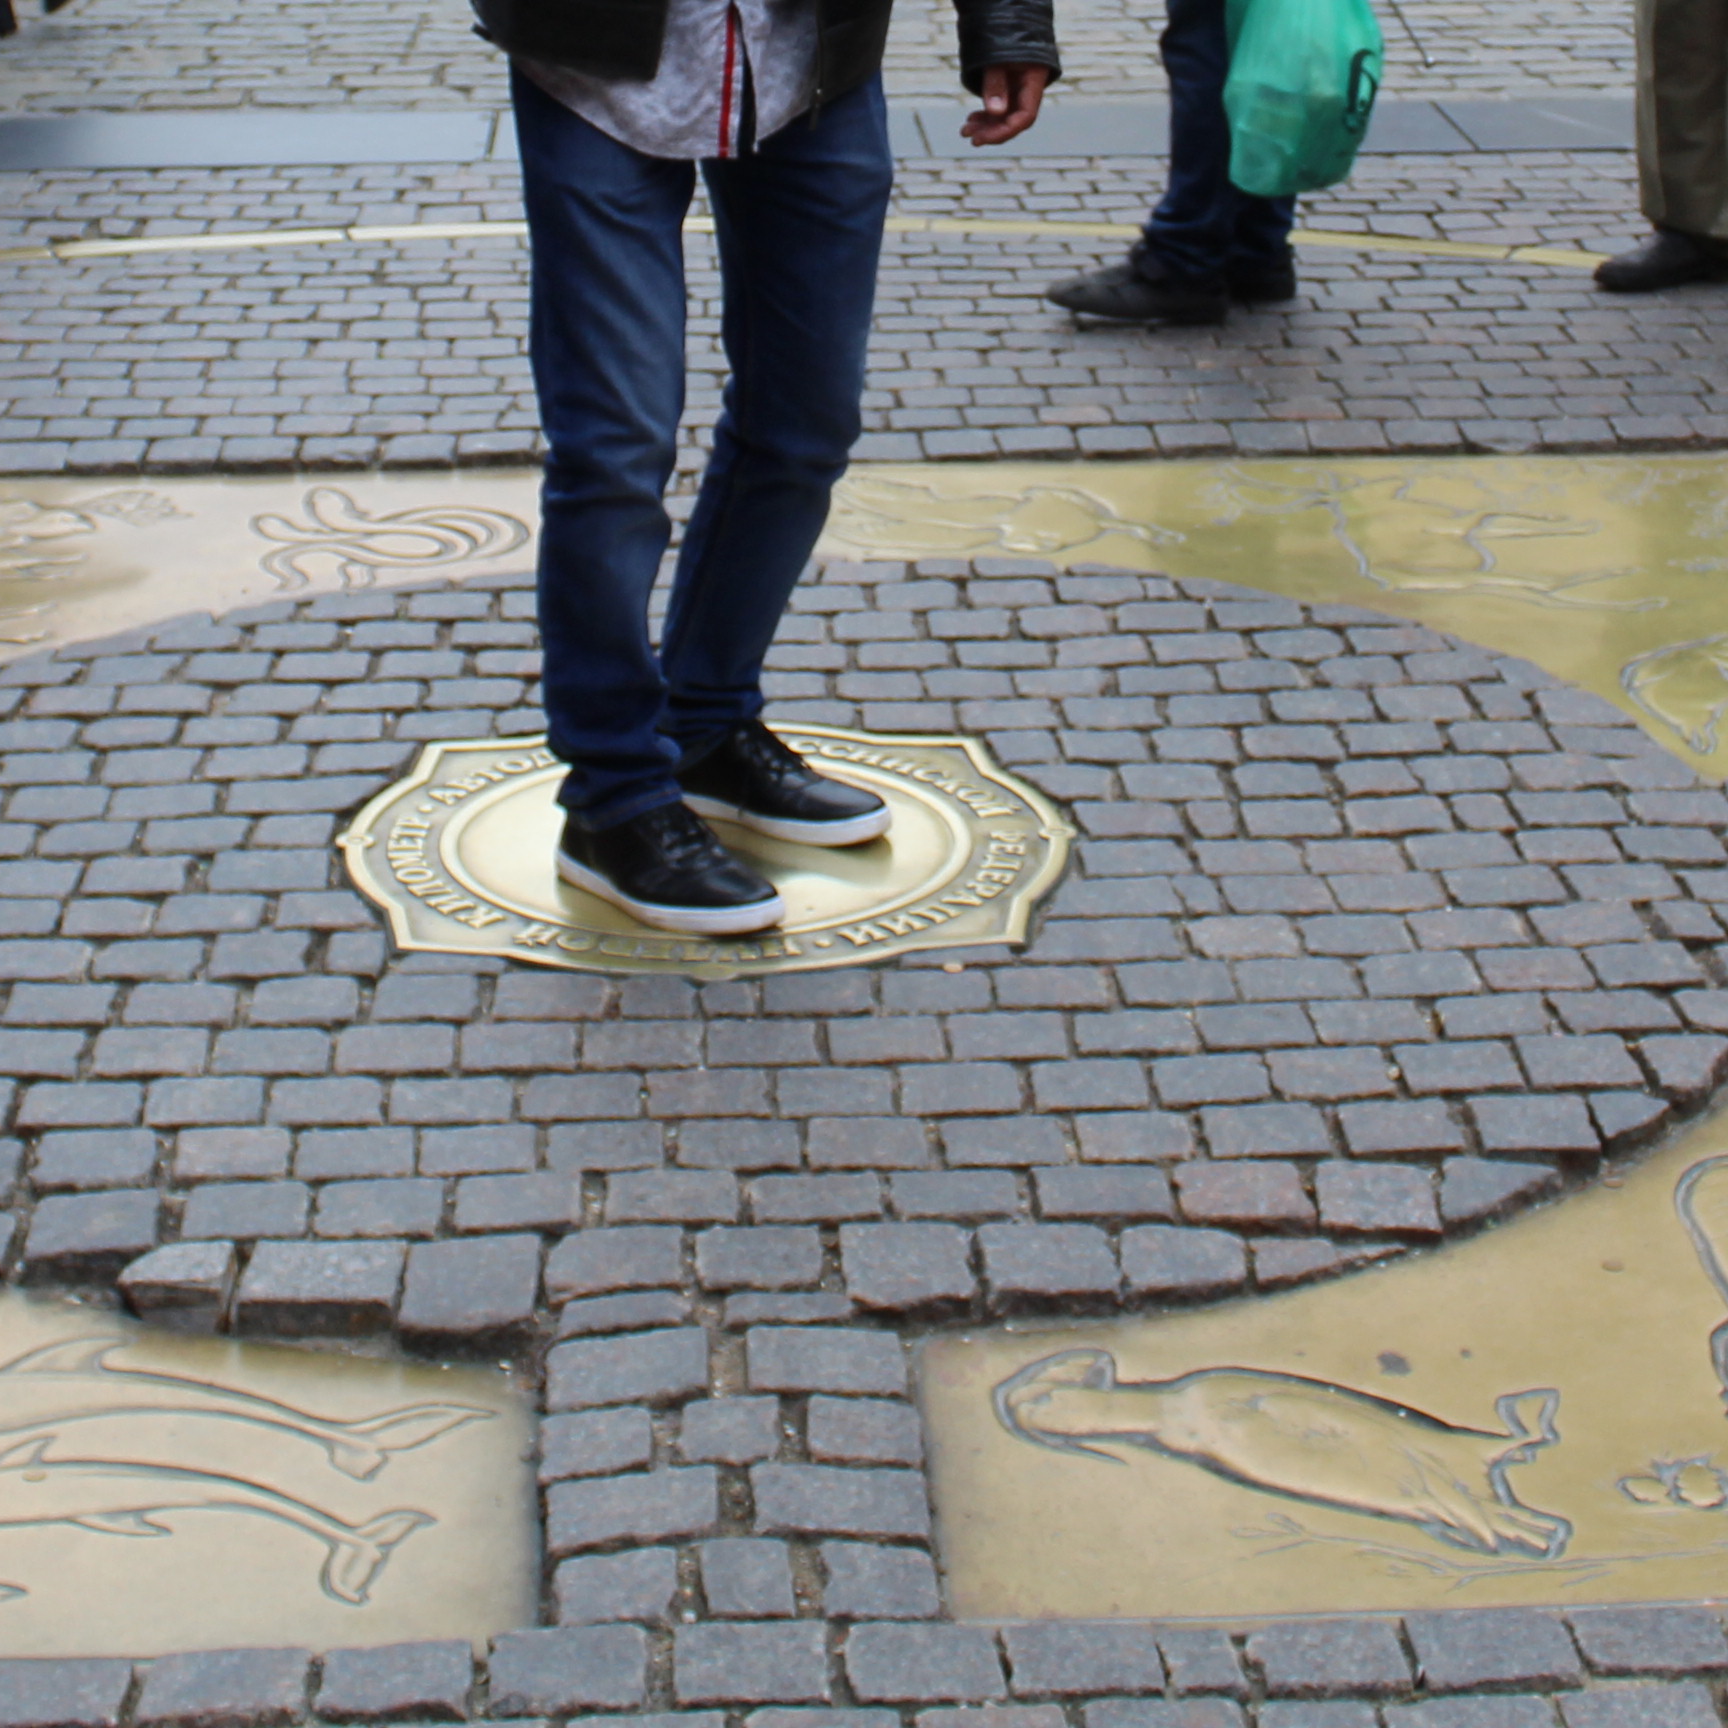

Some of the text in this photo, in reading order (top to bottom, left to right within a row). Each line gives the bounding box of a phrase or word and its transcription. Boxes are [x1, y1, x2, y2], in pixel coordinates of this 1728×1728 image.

[428, 749, 558, 805] АВТОД
[786, 740, 1021, 818] ССИЙСКОЙ
[387, 816, 506, 929] КИЛОМЕТР
[836, 829, 1027, 947] ФЕДЕРАЦИИ
